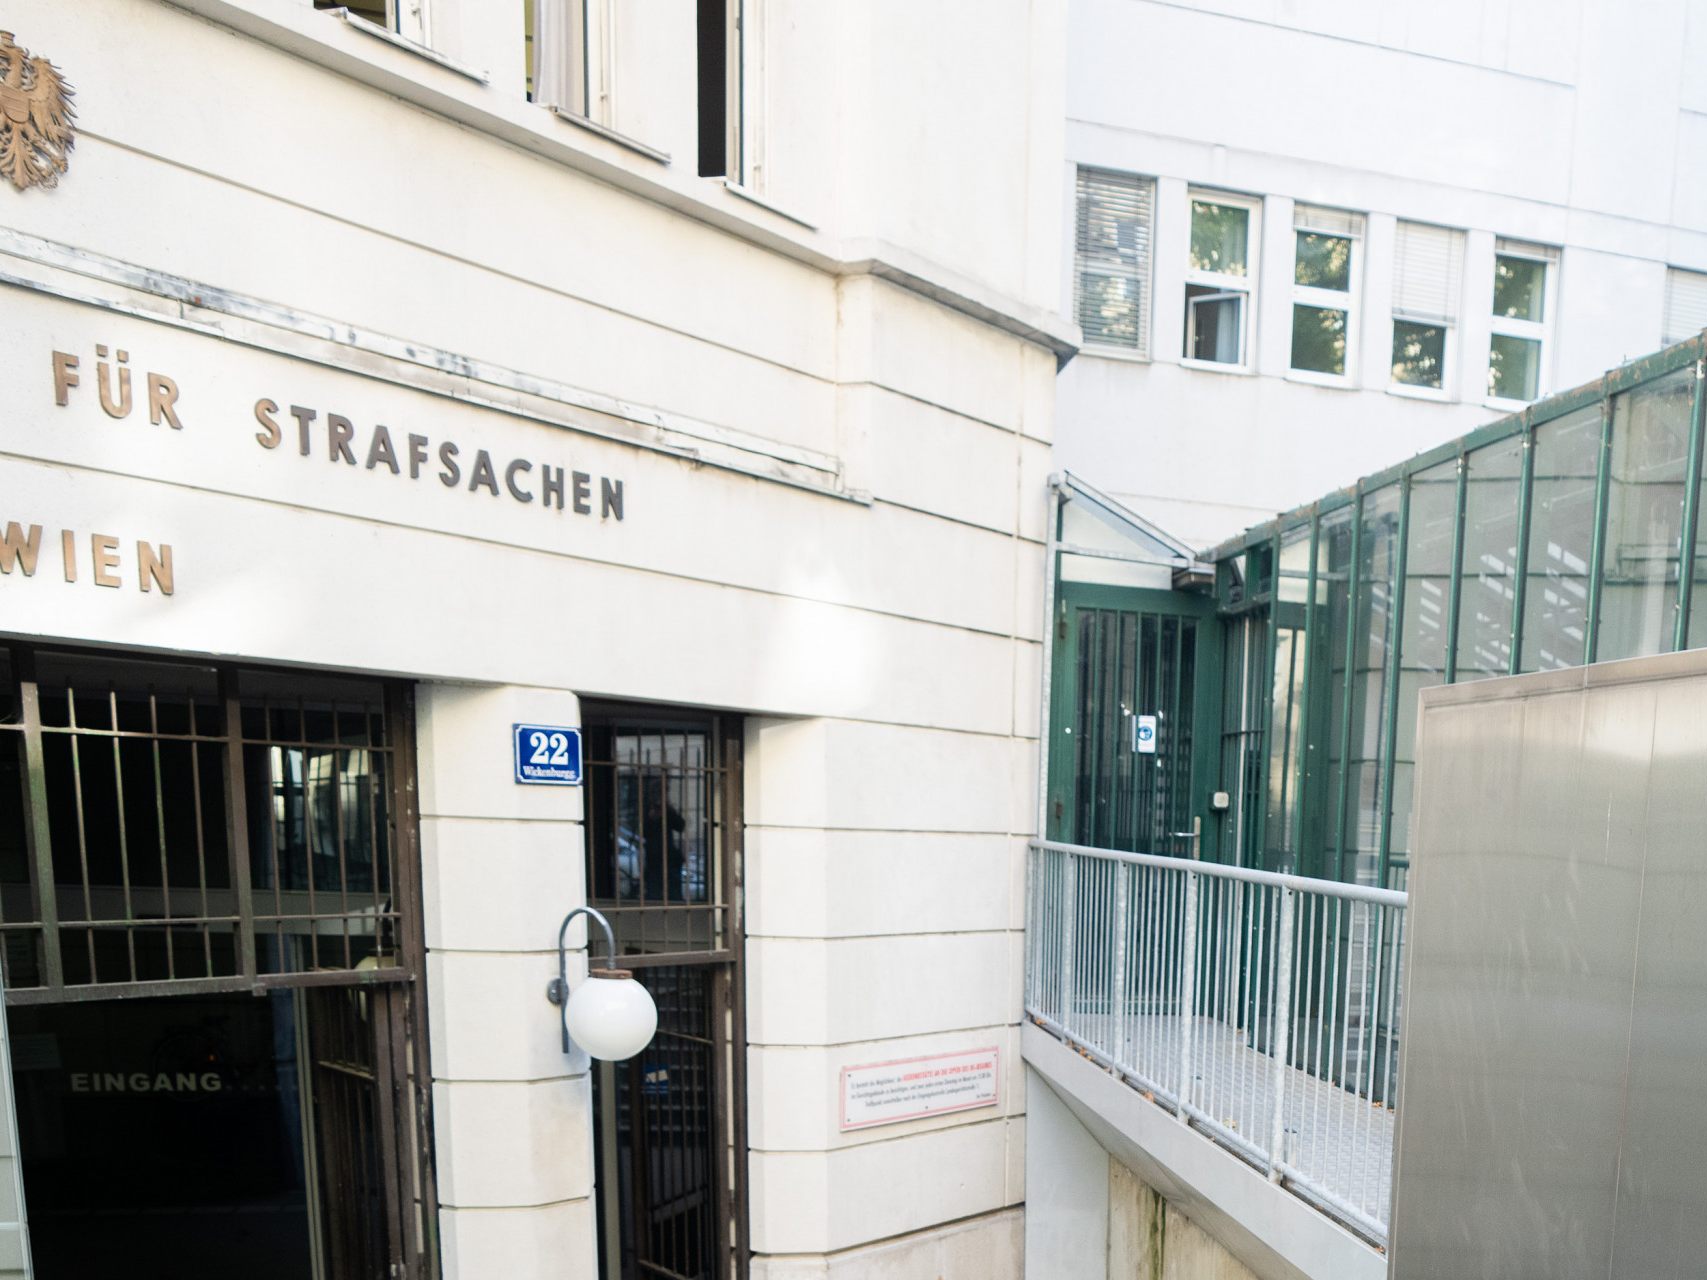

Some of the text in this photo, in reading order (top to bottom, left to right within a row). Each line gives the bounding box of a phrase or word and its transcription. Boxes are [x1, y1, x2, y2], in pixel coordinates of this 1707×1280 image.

[52, 344, 625, 521] FÜR STRAFSACHEN
[0, 521, 174, 596] WIEN
[529, 731, 569, 766] 22
[70, 1072, 222, 1093] EINGANG
